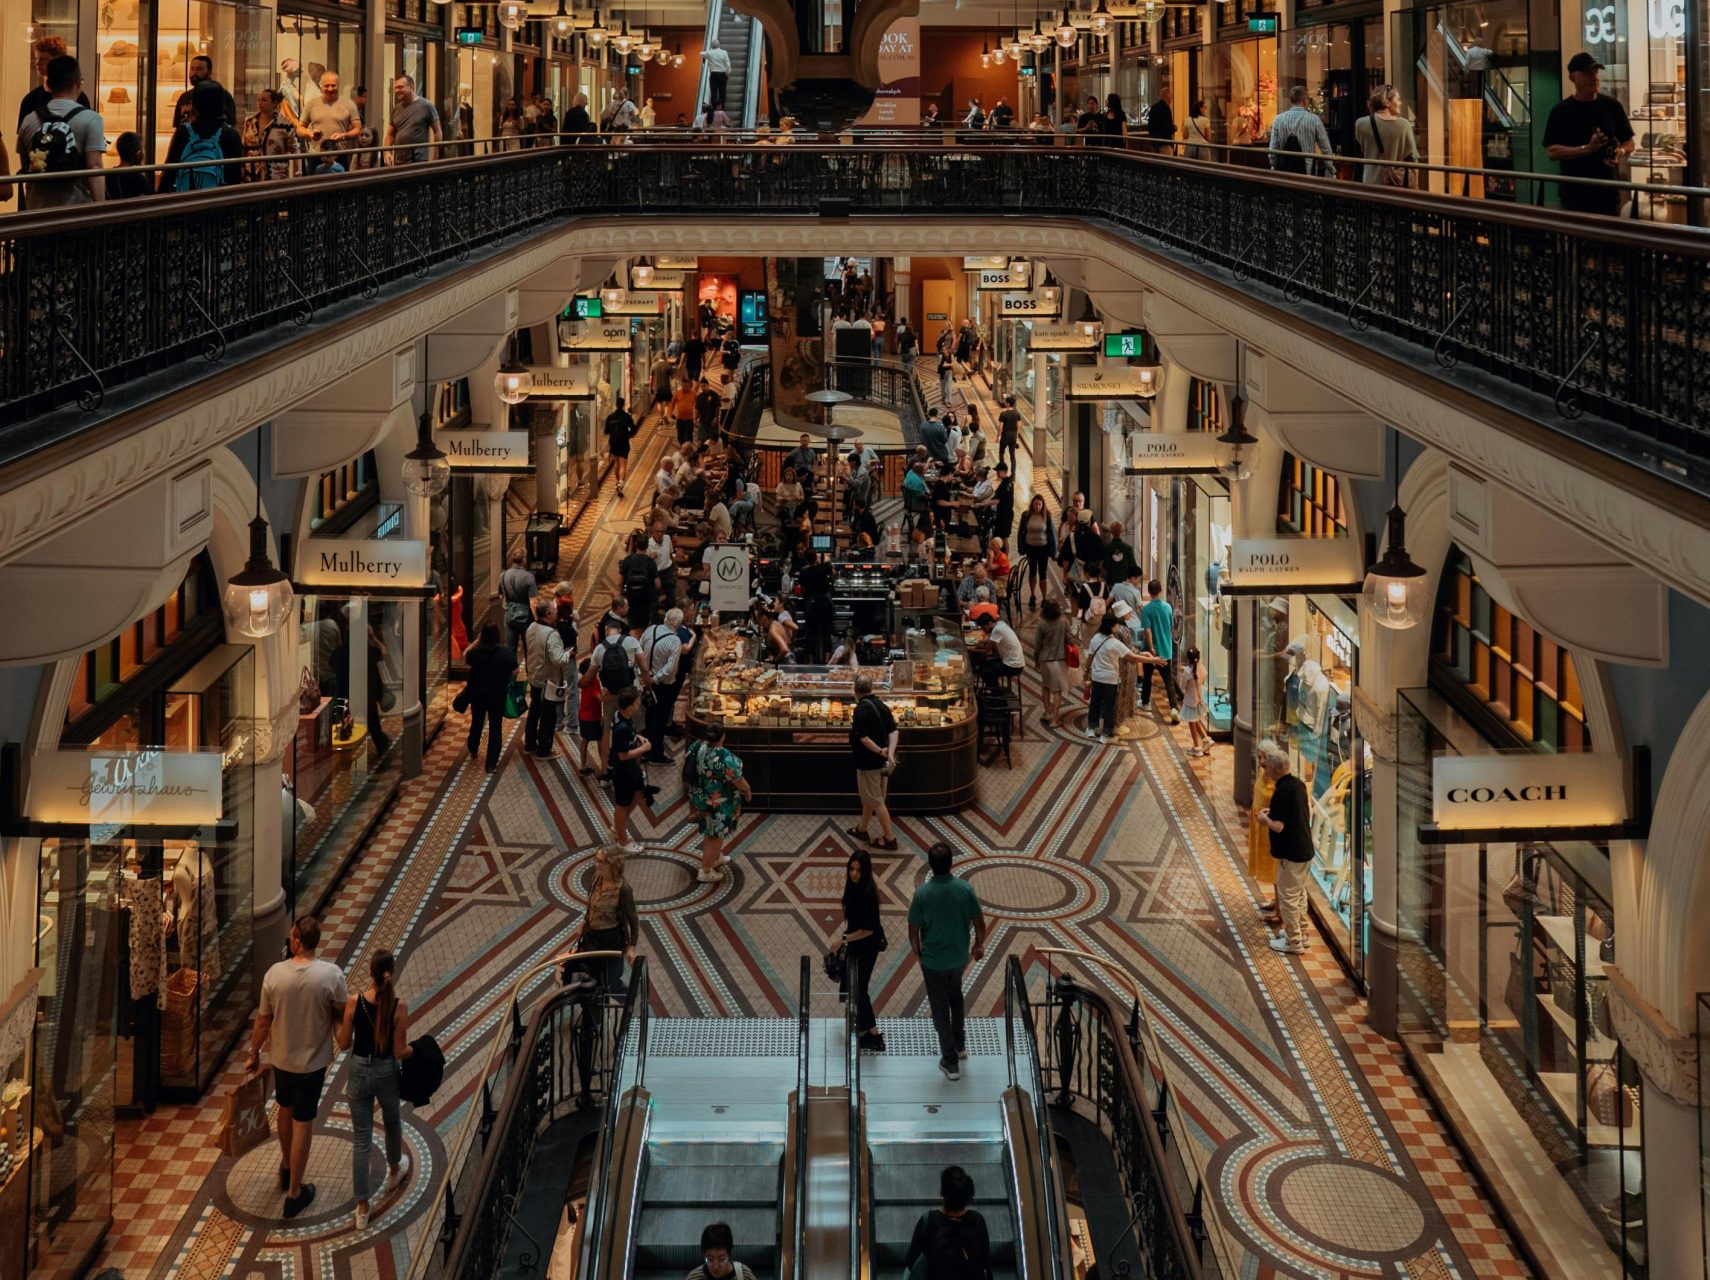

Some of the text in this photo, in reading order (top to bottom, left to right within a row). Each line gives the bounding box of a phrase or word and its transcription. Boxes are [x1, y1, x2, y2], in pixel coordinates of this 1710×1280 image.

[899, 44, 914, 53] AT
[983, 275, 1010, 283] BOSS
[1005, 300, 1037, 309] BOSS
[603, 328, 627, 340] apm
[1034, 329, 1069, 339] kate spade
[1077, 383, 1121, 391] SWAROVSKI
[449, 439, 511, 460] Mulberry
[1147, 443, 1177, 452] POLO
[320, 551, 402, 578] Mulberry
[1250, 553, 1289, 566] POLO
[1447, 784, 1568, 803] COACH
